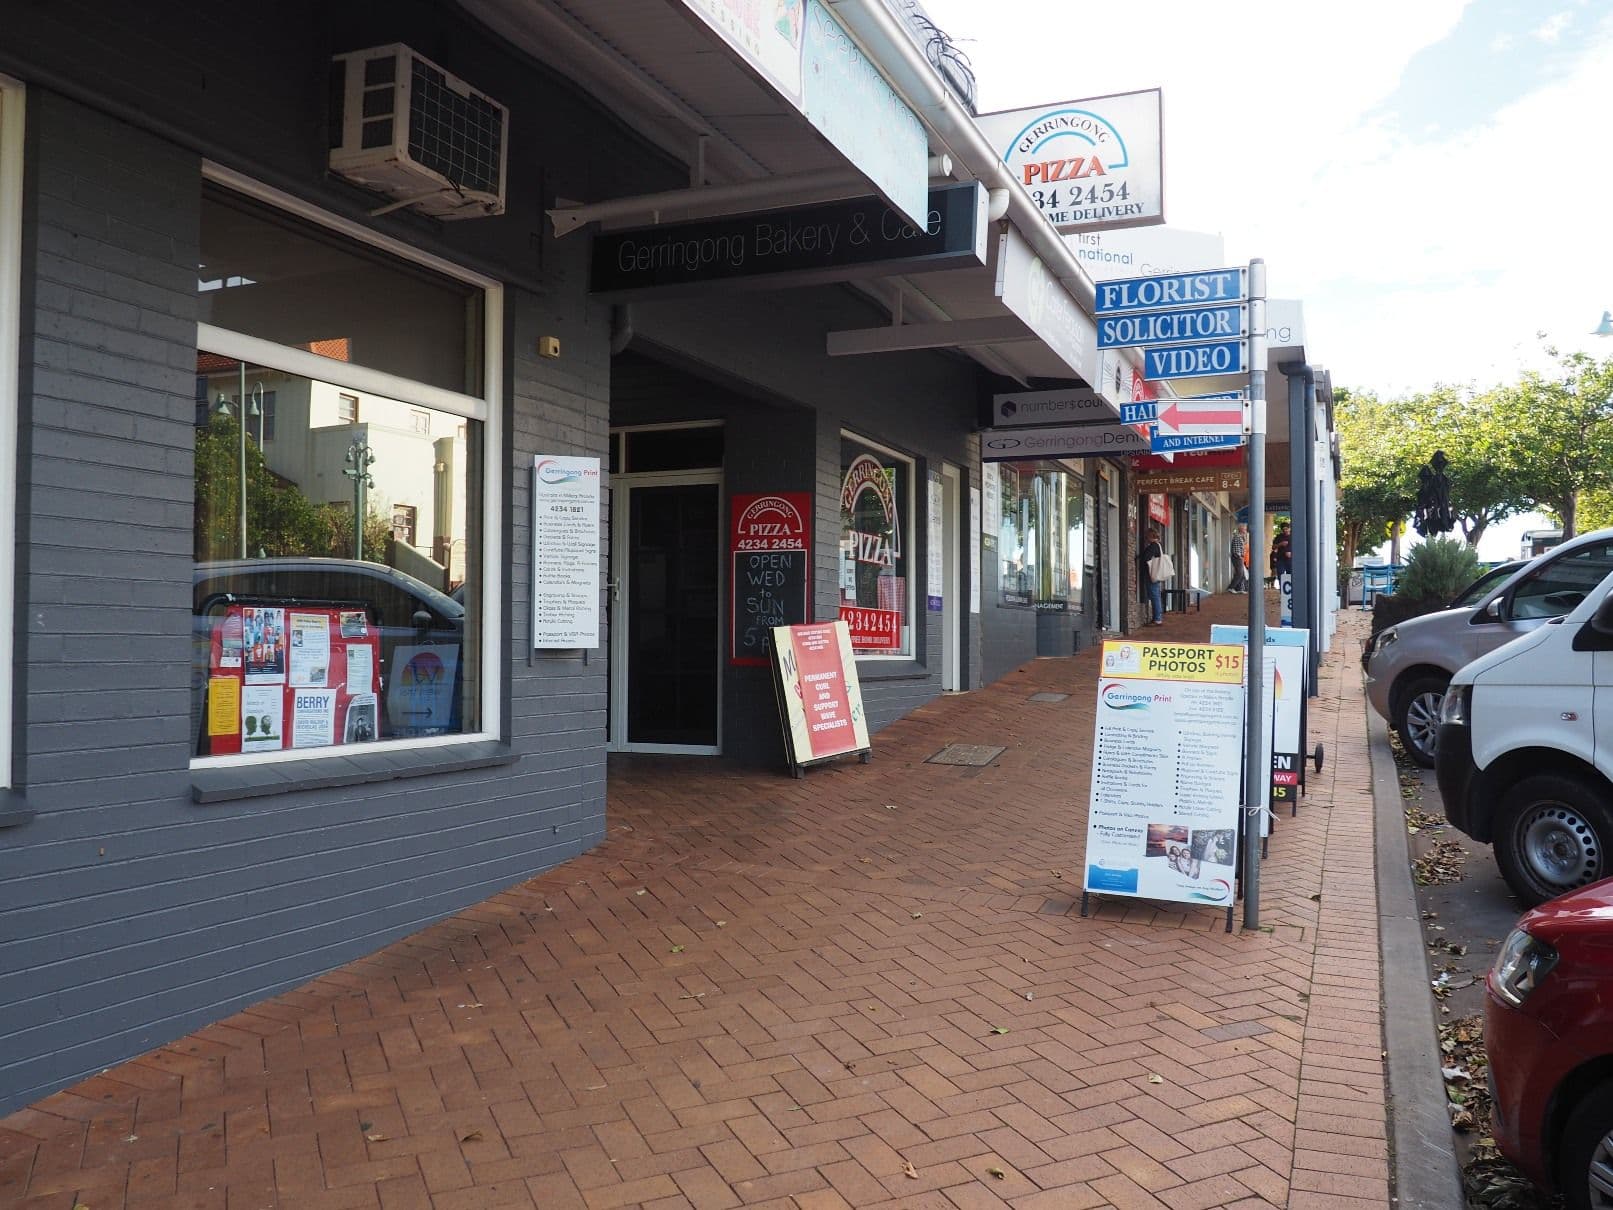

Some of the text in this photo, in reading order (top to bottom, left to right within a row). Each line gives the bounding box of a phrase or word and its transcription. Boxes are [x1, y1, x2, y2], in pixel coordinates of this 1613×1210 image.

[1019, 116, 1111, 153] GERRINGONG
[1023, 156, 1106, 185] PIZZA
[1032, 181, 1130, 210] 34 2454
[1048, 202, 1145, 223] ME DELIVERY
[618, 206, 942, 271] Gerringong Bakery & Cae
[1078, 248, 1133, 265] national
[1102, 273, 1231, 309] FLORIST
[1103, 310, 1232, 344] SOLICITOR
[1152, 346, 1231, 375] VIDEO
[1163, 435, 1224, 448] AND INTERNET
[1137, 475, 1215, 486] PERFECT BREAK CAFE
[843, 462, 893, 519] GERRINGONG
[747, 500, 794, 519] GERRINGONG
[750, 523, 791, 536] PIZZA
[738, 538, 803, 550] 4234 2454
[849, 531, 894, 566] PIZZA
[750, 554, 792, 569] OPEN
[747, 570, 785, 586] WED
[760, 588, 772, 598] to
[746, 597, 784, 616] SUN
[756, 615, 784, 626] FROM
[1142, 646, 1215, 660] PASSPORT
[1149, 660, 1206, 673] PHOTOS
[1215, 654, 1240, 670] $15
[296, 695, 330, 709] BERRY
[1107, 692, 1172, 703] Gerringong Print
[812, 719, 848, 732] SPECIALISTS
